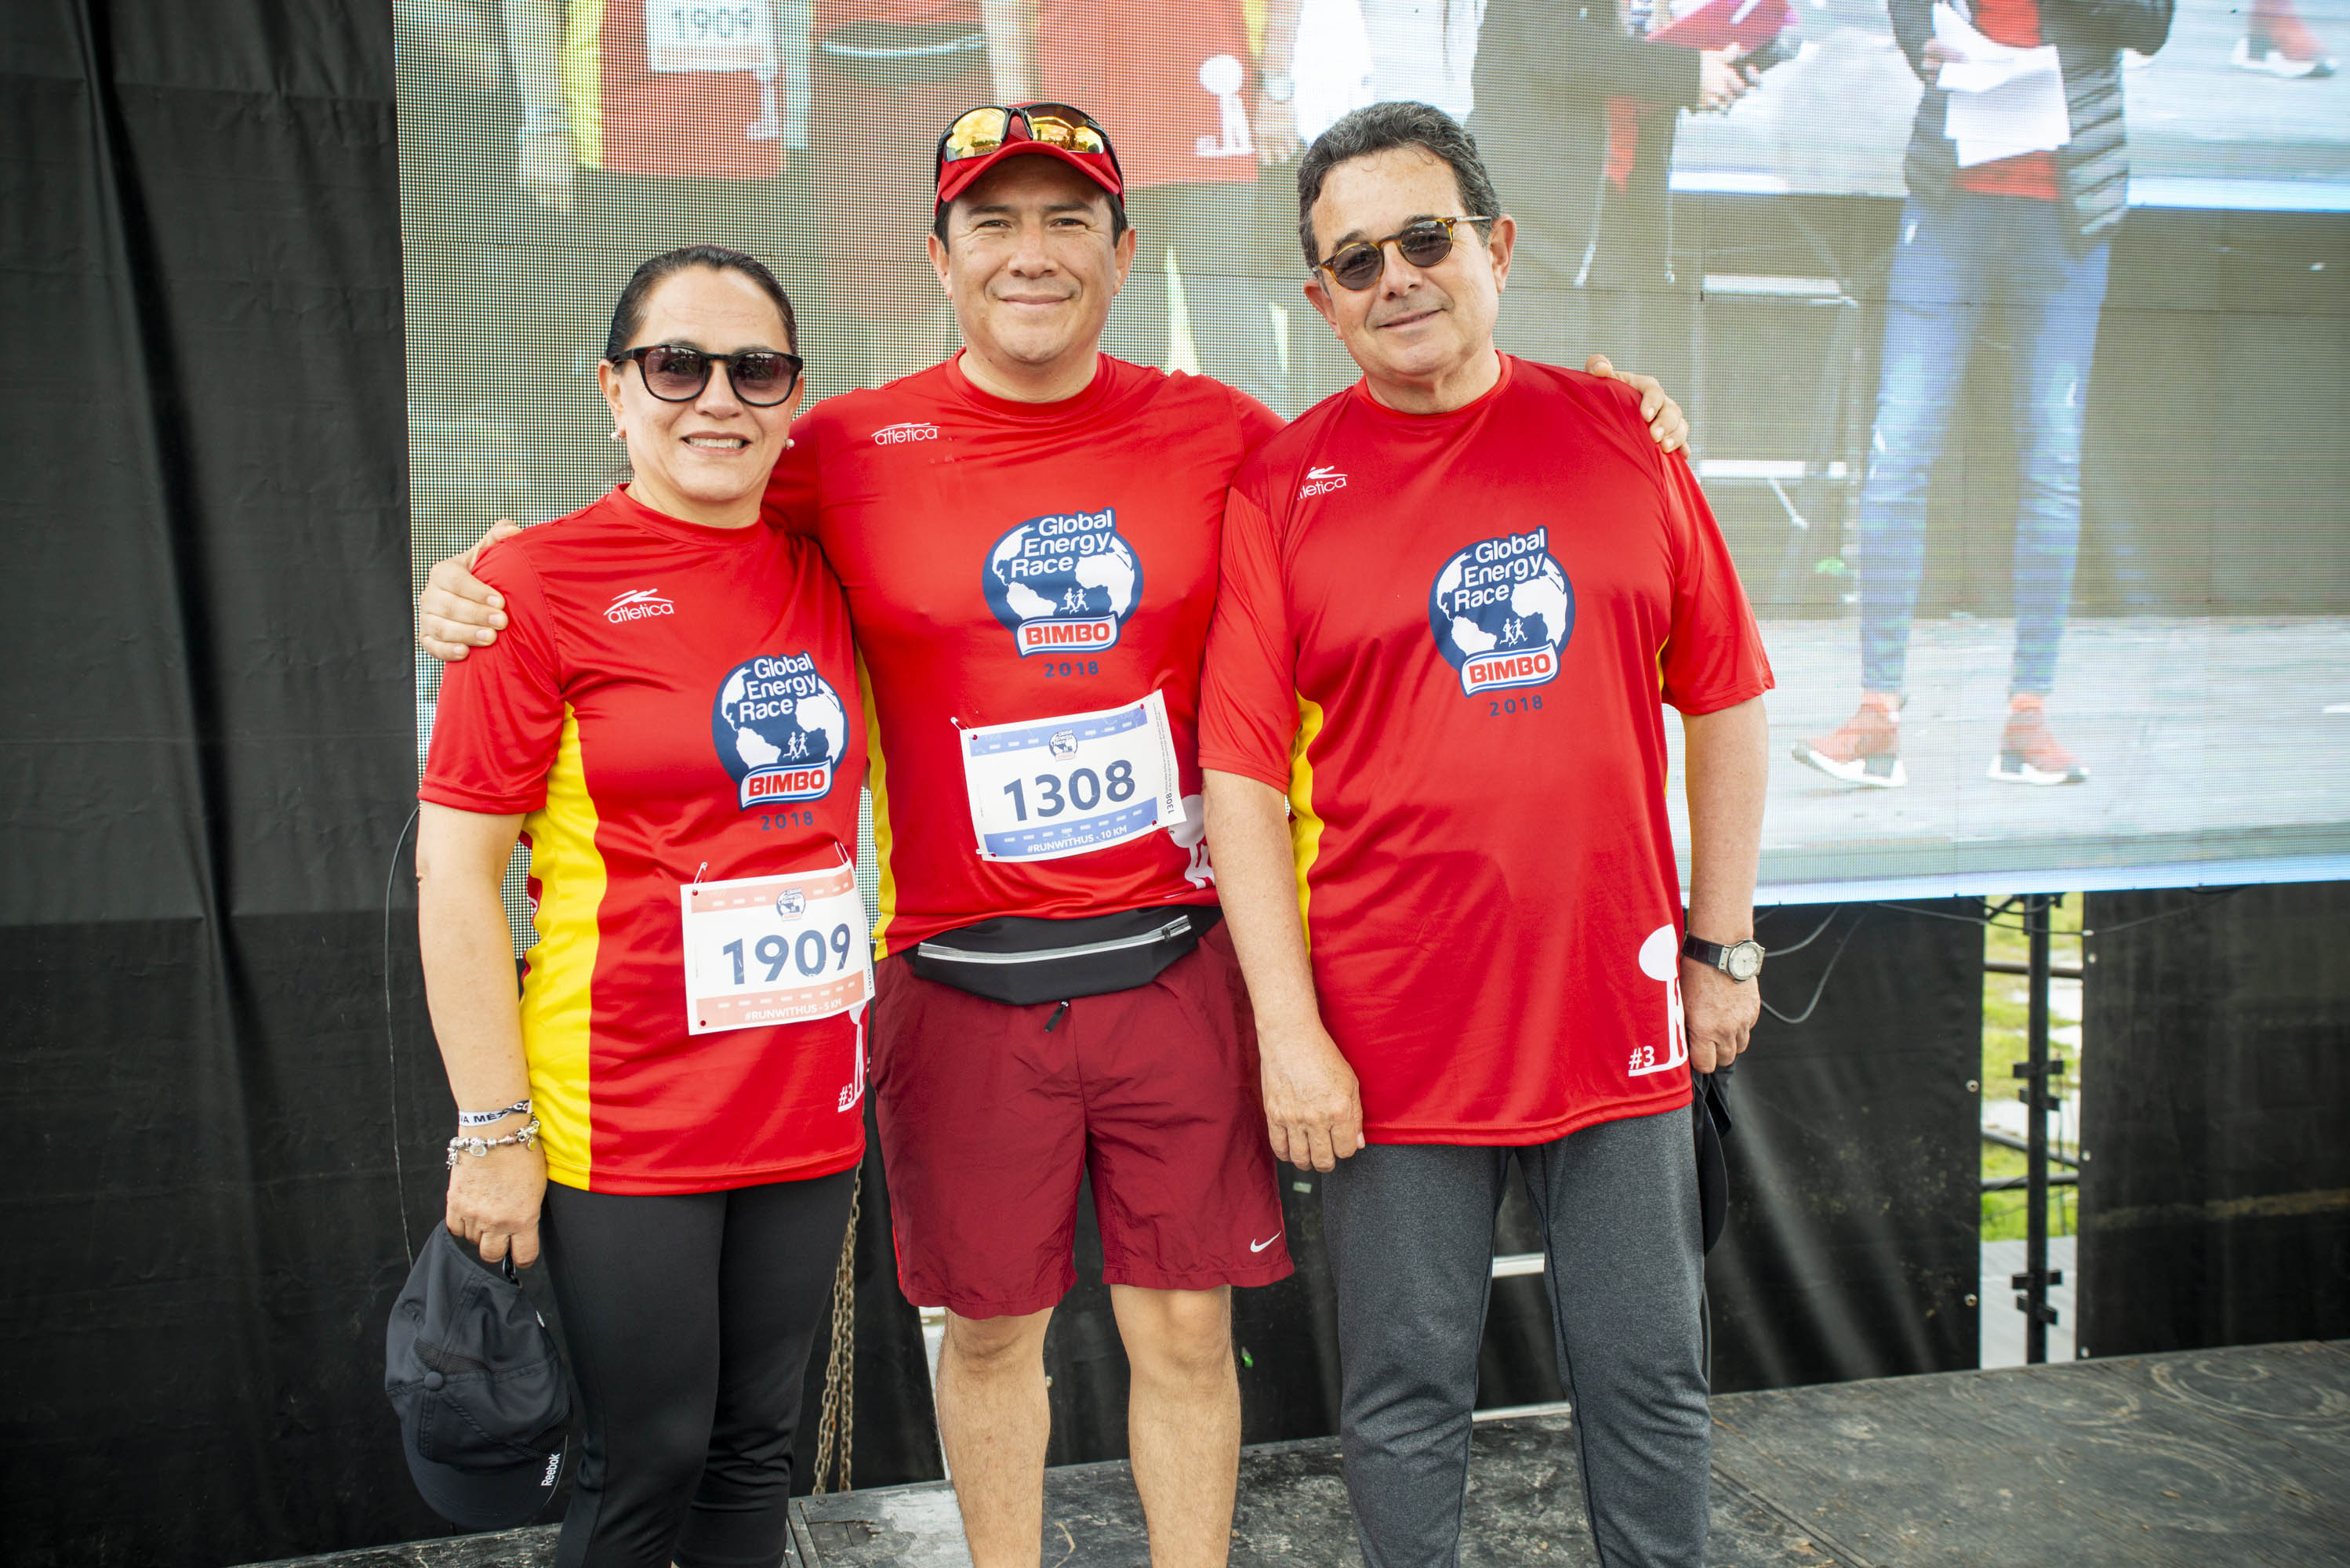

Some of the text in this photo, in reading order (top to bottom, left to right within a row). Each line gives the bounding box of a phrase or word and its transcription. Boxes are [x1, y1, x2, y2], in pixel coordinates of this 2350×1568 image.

[874, 426, 939, 445] atletica
[1296, 477, 1347, 501] letica
[1038, 510, 1112, 537] Global
[1024, 532, 1111, 557] Energy
[1475, 528, 1545, 564] Global
[1011, 555, 1073, 579] Race
[1464, 553, 1544, 588] Energy
[1455, 583, 1510, 612] Race
[608, 601, 674, 624] atletica
[1026, 622, 1111, 646] BIMBO
[754, 652, 814, 679] Global
[1044, 661, 1099, 678] 2018
[1469, 653, 1551, 684] BIMBO
[746, 673, 819, 700] Energy
[739, 697, 794, 723] Race
[1489, 695, 1544, 717] 2018
[747, 769, 826, 798] BIMBO
[1004, 760, 1136, 822] 1308
[1166, 793, 1175, 814] 1308
[761, 811, 814, 831] 2018
[1027, 833, 1095, 854] #RUNWITHUS
[1100, 829, 1111, 841] 10
[1112, 826, 1128, 838] KM
[722, 923, 851, 985] 1909
[746, 1004, 818, 1021] #RUNWITHUS
[831, 998, 843, 1009] KM
[1629, 1045, 1655, 1070] #3
[838, 1083, 854, 1106] #3
[541, 1453, 561, 1486] Reebok
